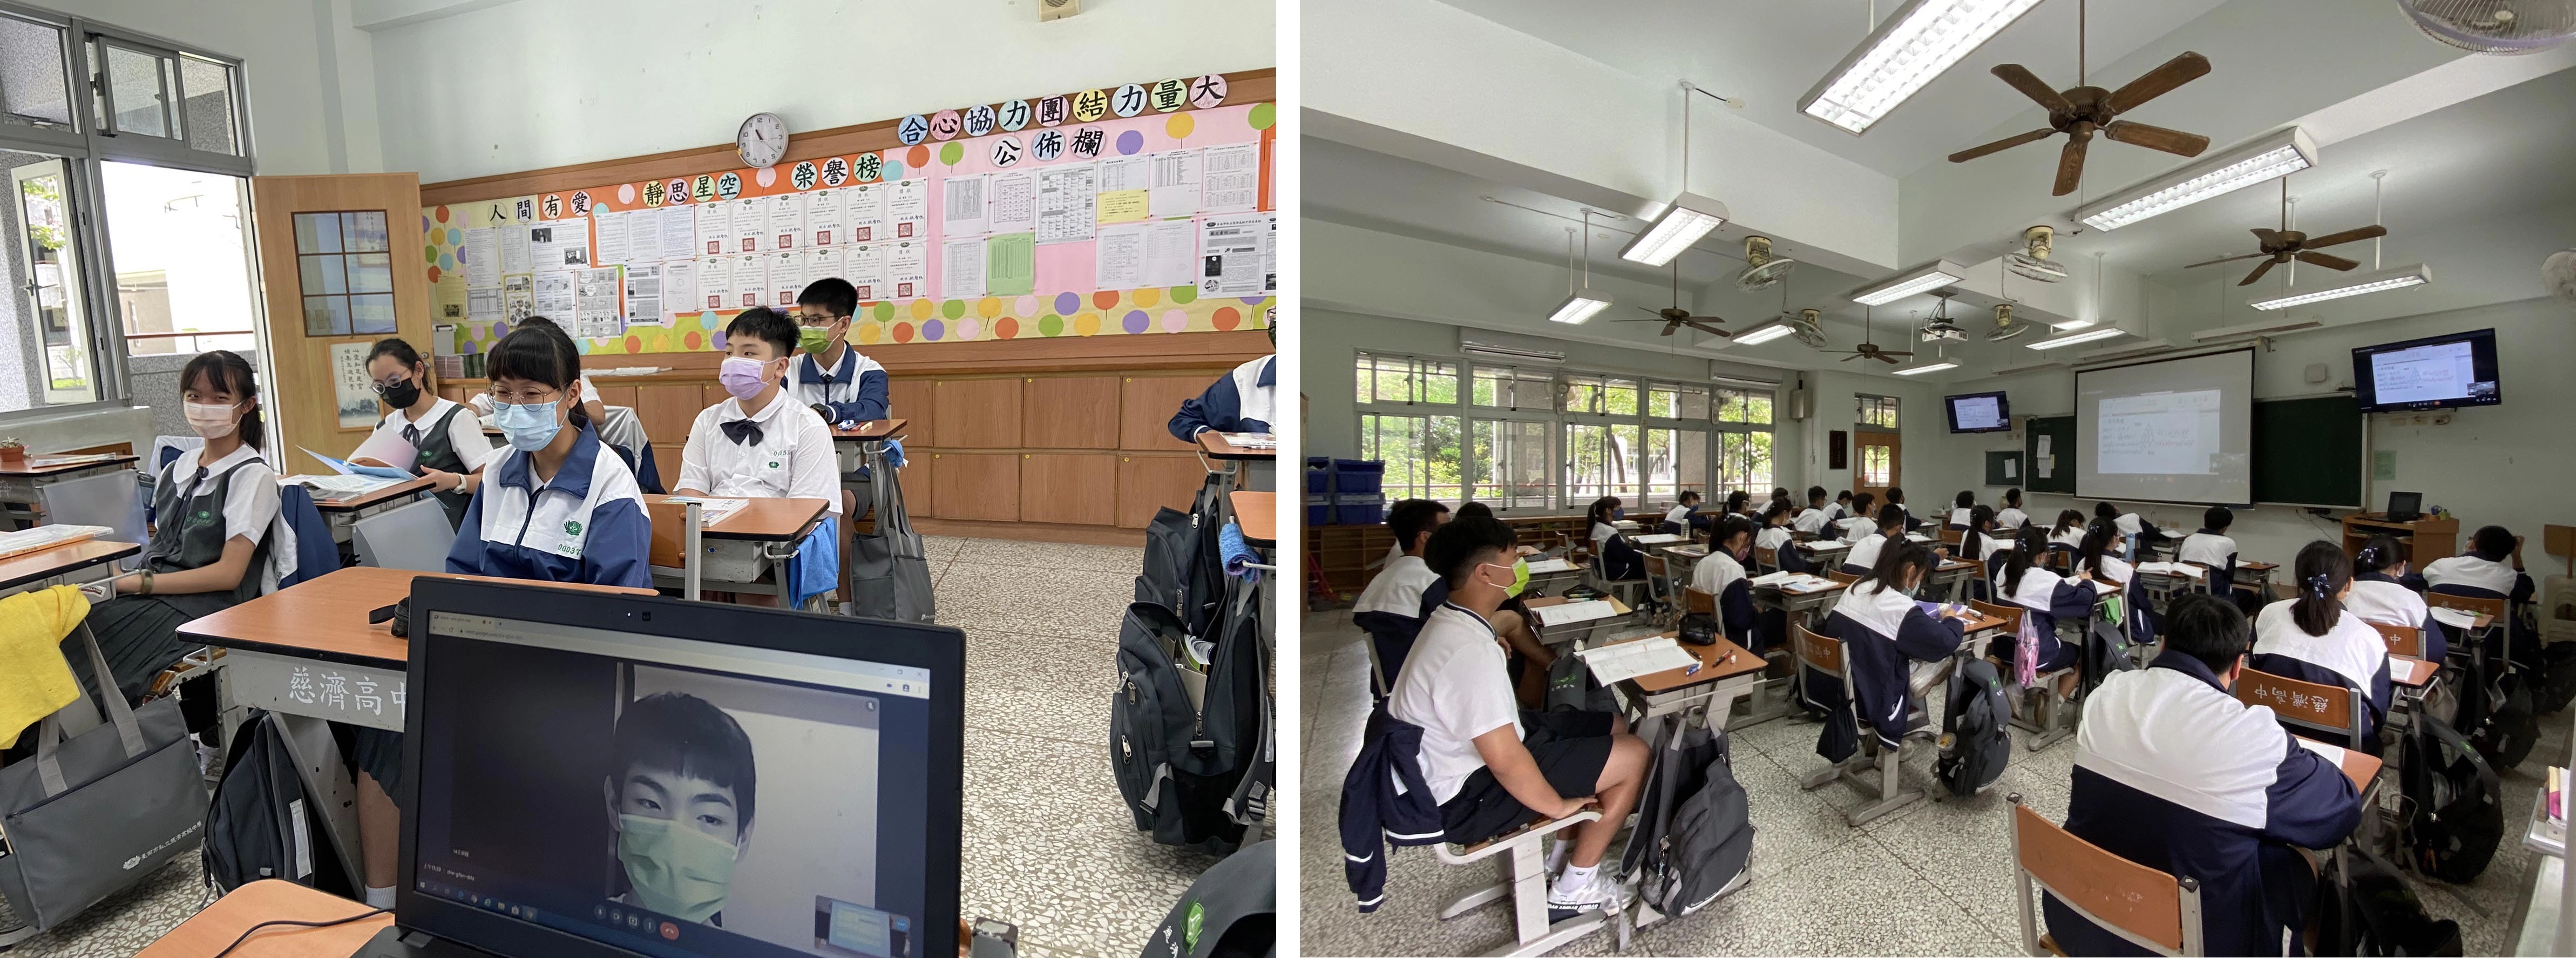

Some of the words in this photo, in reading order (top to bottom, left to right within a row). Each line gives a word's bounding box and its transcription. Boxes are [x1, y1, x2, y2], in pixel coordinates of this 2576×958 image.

[901, 77, 1224, 143] 合心協力團結力量大
[995, 129, 1104, 165] 公佈欄
[795, 154, 880, 188] 榮譽榜
[490, 192, 589, 221] 人間有愛
[645, 176, 738, 205] 靜思星空
[558, 544, 581, 556] 00037
[289, 666, 406, 720] 慈濟高中
[2254, 683, 2329, 713] 慈濟高中
